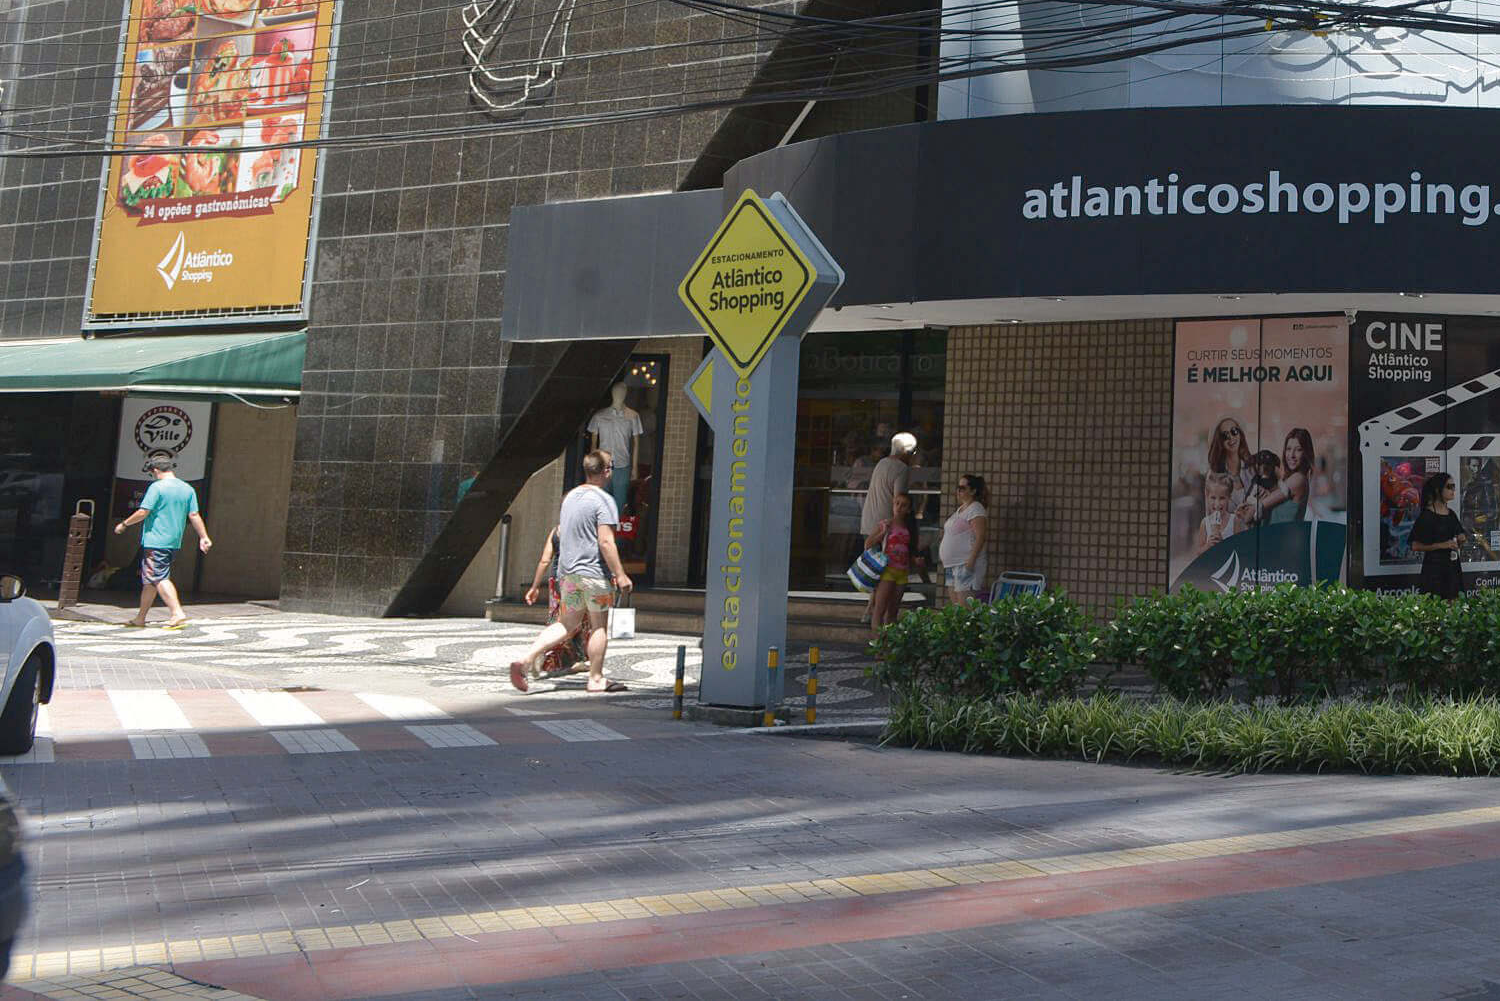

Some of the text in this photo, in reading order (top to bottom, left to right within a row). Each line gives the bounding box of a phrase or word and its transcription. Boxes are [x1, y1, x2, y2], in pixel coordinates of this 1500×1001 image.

[144, 204, 155, 218] 34
[159, 203, 192, 221] opções
[184, 249, 234, 268] Atlântico
[711, 249, 784, 264] ESTACIONAMENTO
[182, 269, 213, 283] Shopping
[711, 266, 783, 290] Atlântico
[709, 288, 784, 314] Shopping
[1365, 321, 1443, 351] CINE
[1188, 347, 1333, 361] CURTIR SEUS MOMENTOS
[1368, 353, 1429, 366] Atlântico
[1188, 363, 1333, 383] É MELHOR AQUI
[1368, 367, 1432, 382] Shopping
[144, 430, 180, 443] Ville
[720, 376, 752, 671] estacionamento
[1241, 567, 1298, 582] Atlântico
